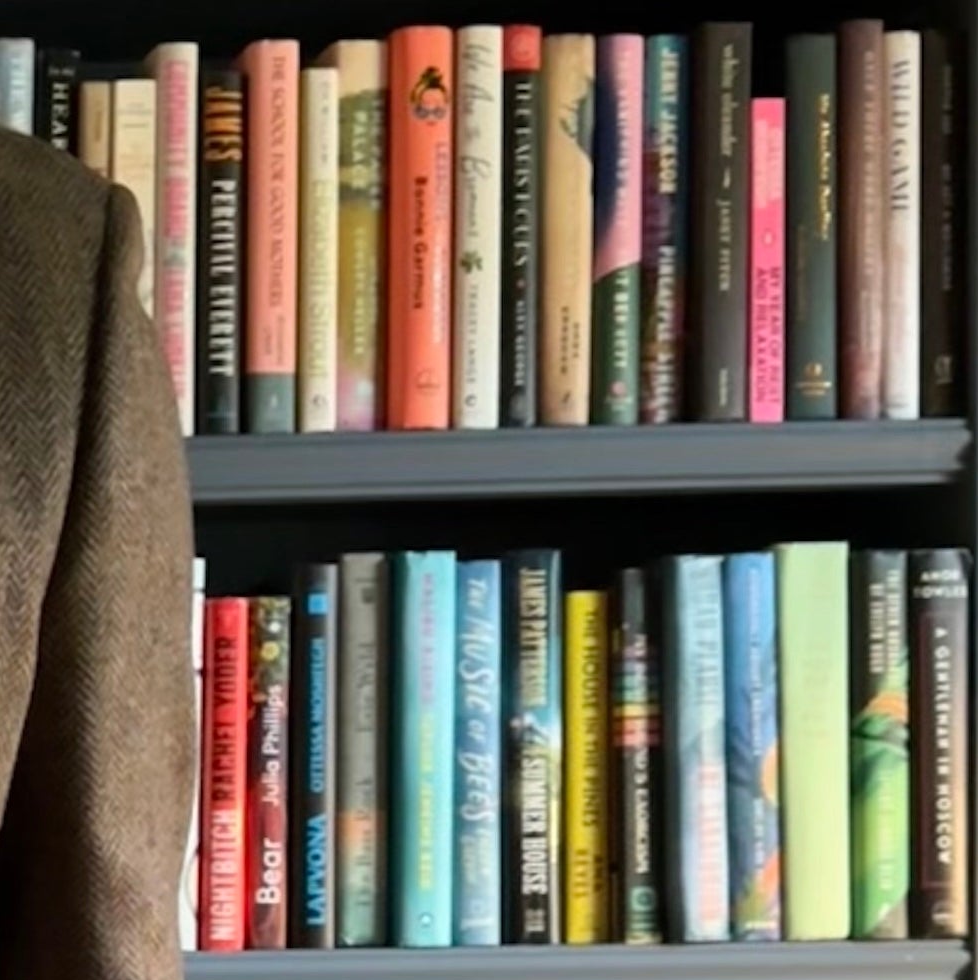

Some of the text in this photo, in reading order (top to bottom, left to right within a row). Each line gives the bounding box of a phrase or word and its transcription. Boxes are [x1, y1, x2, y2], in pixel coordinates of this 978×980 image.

[205, 87, 243, 162] JAMES
[270, 87, 286, 148] SCHOOL
[658, 109, 678, 195] JACKSON
[890, 60, 911, 211] WILD GAME
[269, 187, 285, 235] GOOD
[412, 177, 428, 309] Bonnie Garmus
[209, 179, 237, 377] PERCIVAL EVERETT
[268, 238, 284, 308] MOTHERS
[769, 267, 781, 288] MY
[755, 268, 768, 404] AND RELAXATION
[769, 295, 781, 335] YEAR
[459, 614, 496, 714] MUSIC
[520, 568, 548, 707] JAMES PATTERSON
[583, 645, 600, 708] HOUSE
[261, 684, 284, 807] Julia Phillips
[466, 719, 488, 743] OF
[934, 626, 951, 865] A GENTLEMAN IN MOSCOW
[209, 636, 238, 941] NIGHTBITCH RACHEL YODER
[458, 751, 499, 823] BEES
[521, 757, 548, 833] SUMMER
[255, 837, 284, 904] Bear
[306, 813, 327, 925] LAPVONA
[521, 836, 548, 895] HOUSE
